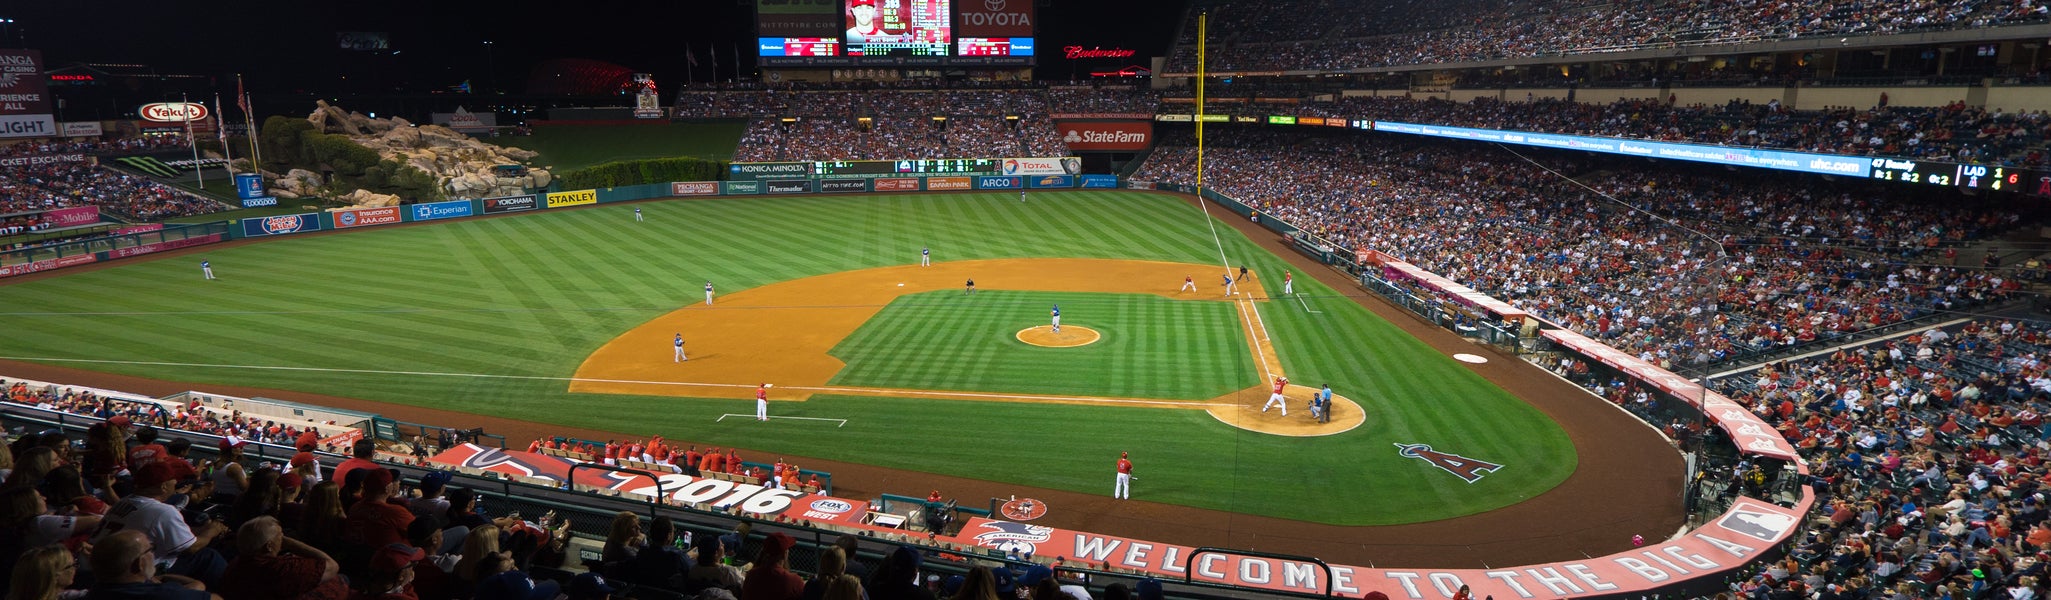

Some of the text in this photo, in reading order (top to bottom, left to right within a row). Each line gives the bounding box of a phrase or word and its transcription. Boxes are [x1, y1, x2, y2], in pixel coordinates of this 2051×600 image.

[961, 12, 1030, 26] TOYOTA
[1063, 45, 1136, 59] Budweiser
[5, 102, 26, 110] ALL
[152, 107, 198, 117] Yakut
[1, 158, 29, 166] CKET
[1810, 159, 1859, 173] uhc.com
[1871, 159, 1885, 168] 47
[741, 165, 772, 173] KONICA
[772, 164, 805, 172] MINOLTA
[1963, 165, 2003, 178] LAD 1
[982, 178, 1010, 187] ARCO
[2008, 174, 2018, 184] 6
[1991, 180, 2001, 190] 4
[497, 197, 534, 206] YOKOHAMA
[548, 192, 595, 204] STANLEY
[359, 208, 394, 217] Insurance
[433, 206, 467, 216] Experian
[360, 216, 395, 225] AAA.com
[630, 474, 804, 514] 2016
[820, 501, 844, 509] FOX
[802, 510, 839, 520] WEST
[1072, 532, 1757, 599] WELCOME TO THE BIG A
